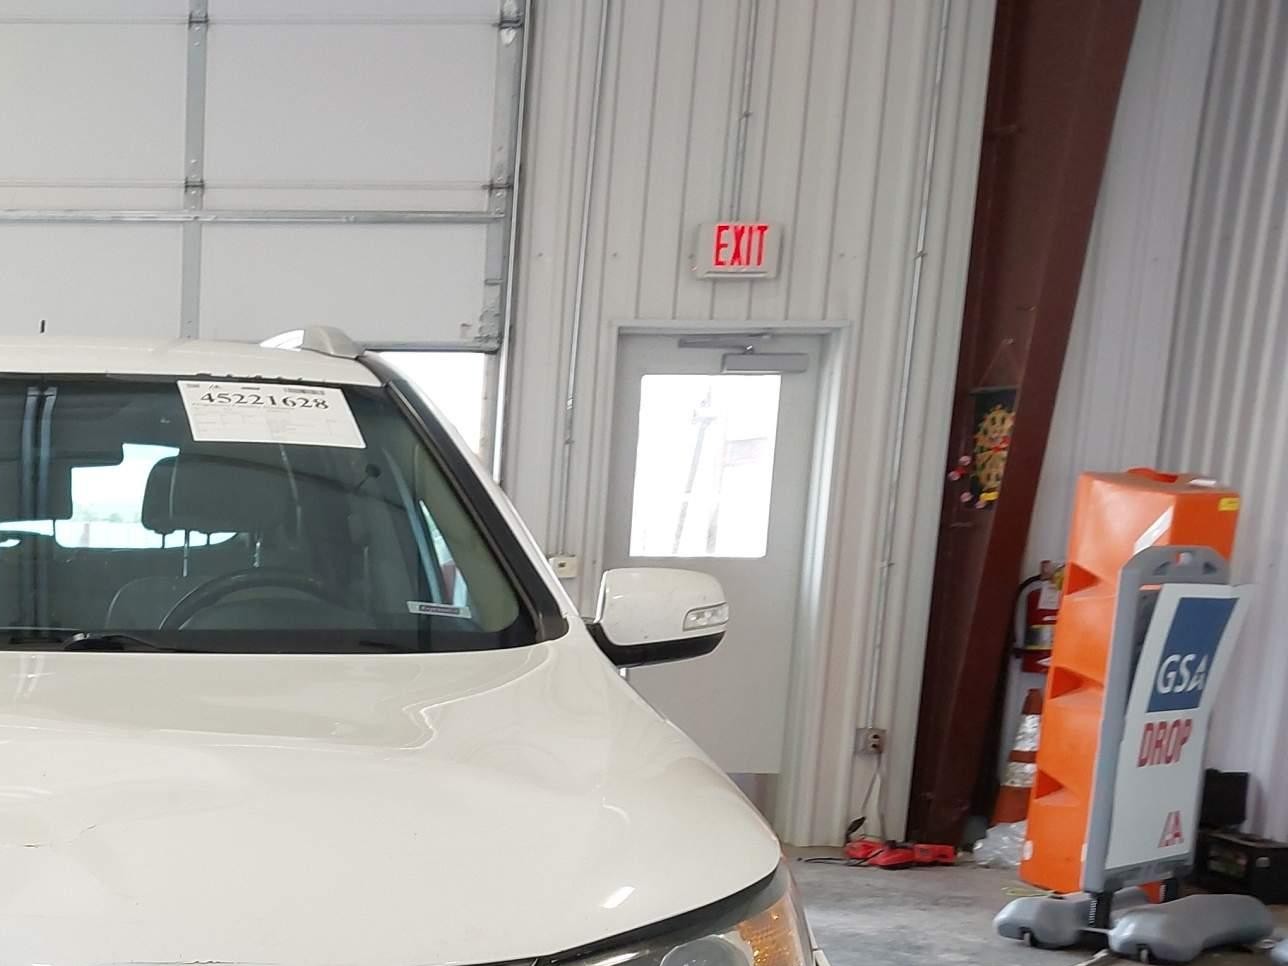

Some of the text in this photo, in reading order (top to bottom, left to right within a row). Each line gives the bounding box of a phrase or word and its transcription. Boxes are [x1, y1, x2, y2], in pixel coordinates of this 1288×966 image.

[714, 224, 768, 266] EXIT
[200, 392, 329, 410] 45221628
[1156, 653, 1208, 694] GSA
[1137, 718, 1192, 768] DROP
